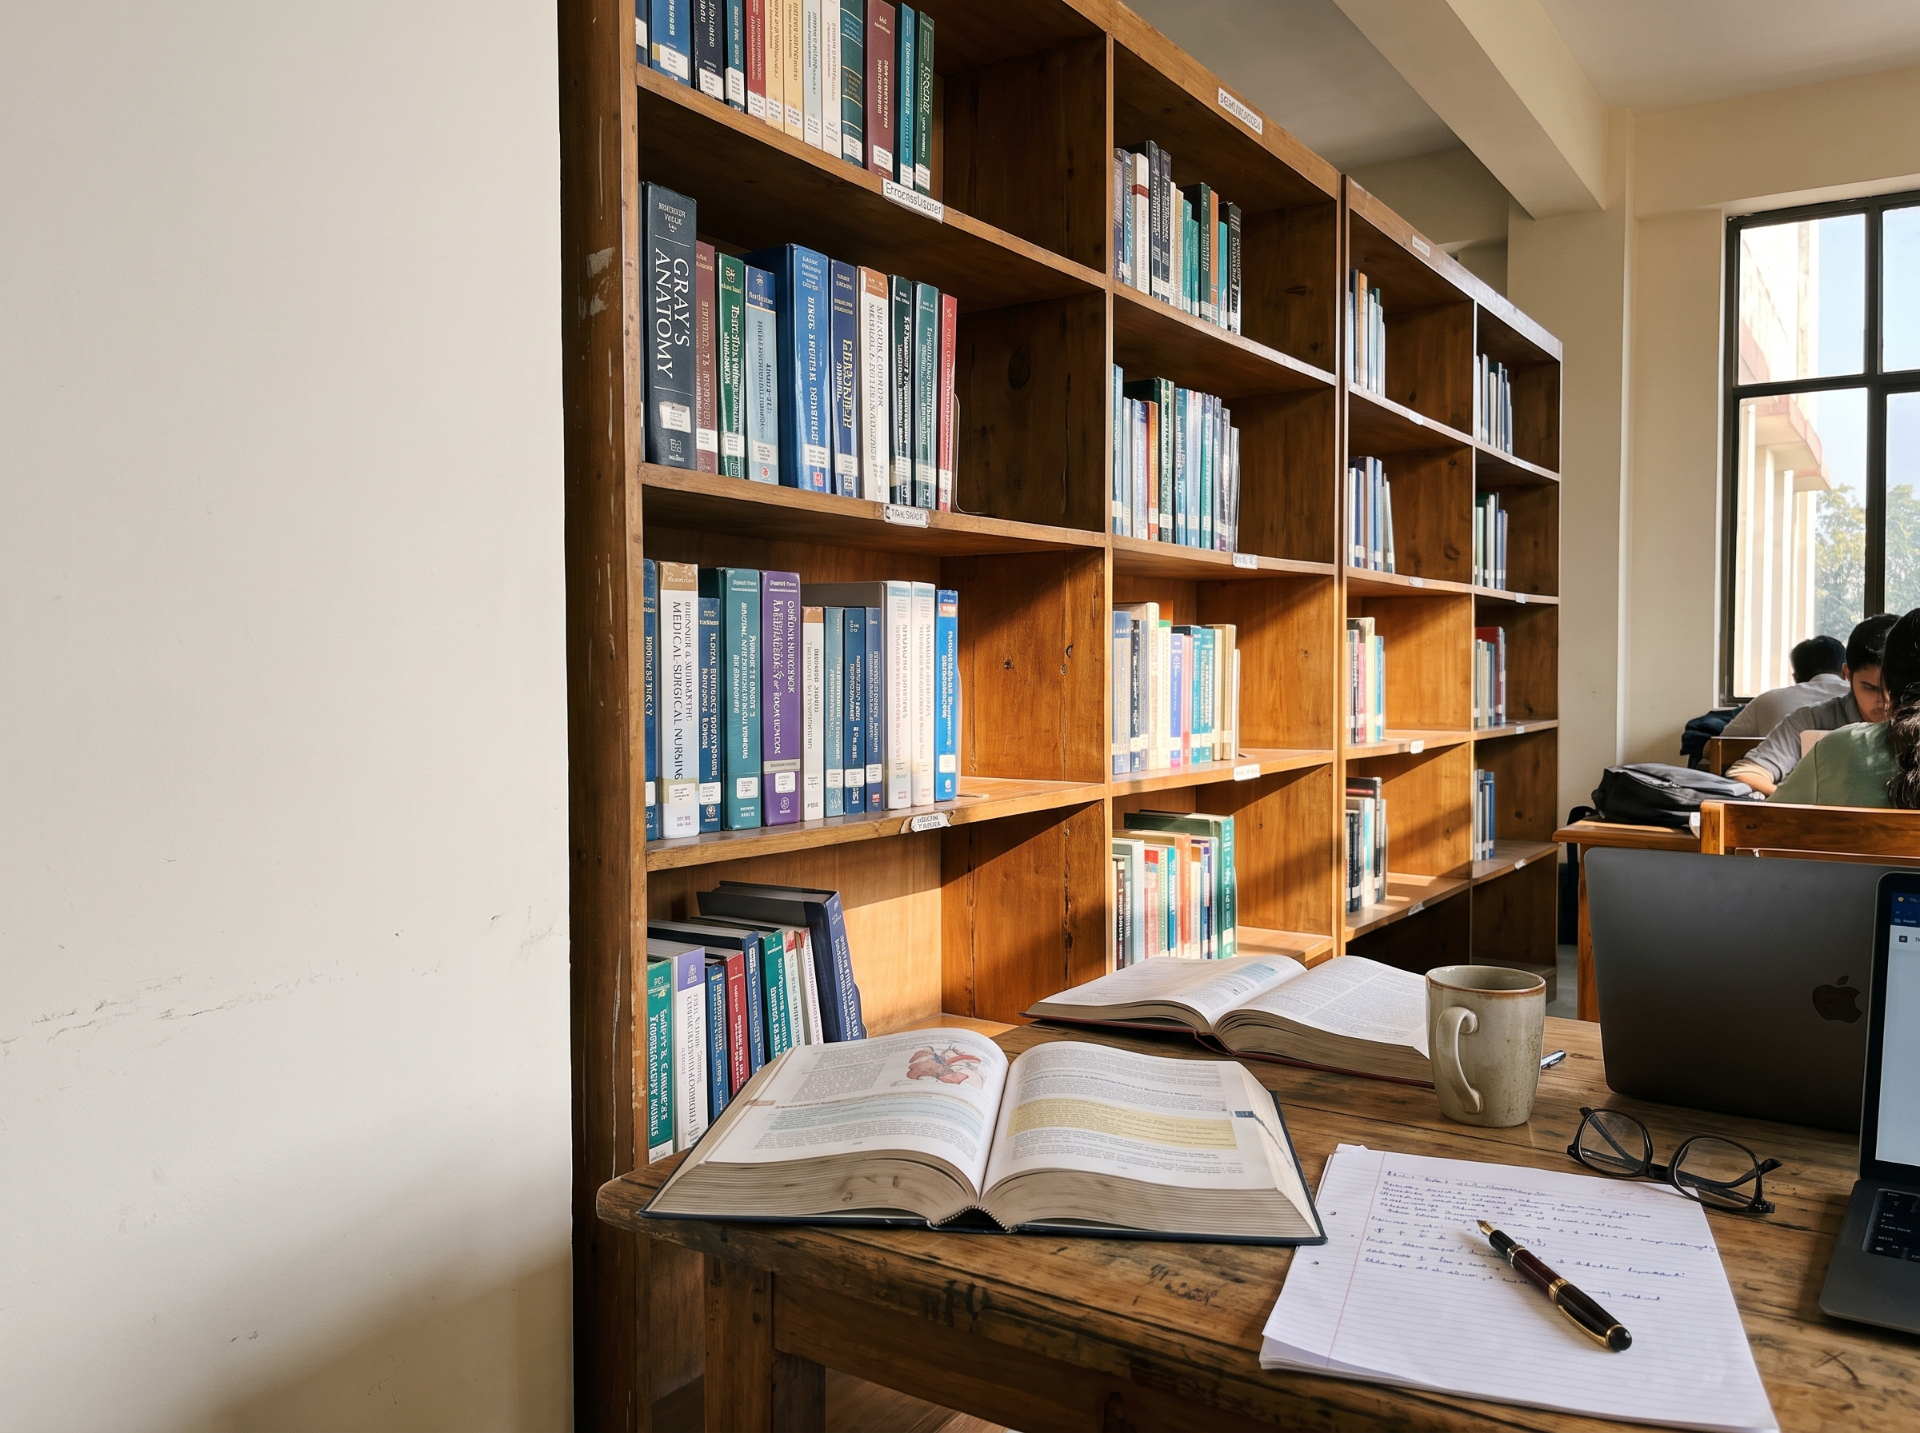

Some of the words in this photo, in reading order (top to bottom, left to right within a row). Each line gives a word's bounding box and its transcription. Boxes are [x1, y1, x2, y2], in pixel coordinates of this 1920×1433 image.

[655, 247, 673, 380] ANATOMY
[673, 257, 691, 347] GRAY'S
[673, 601, 683, 726] MEDICAL-SURGICAL
